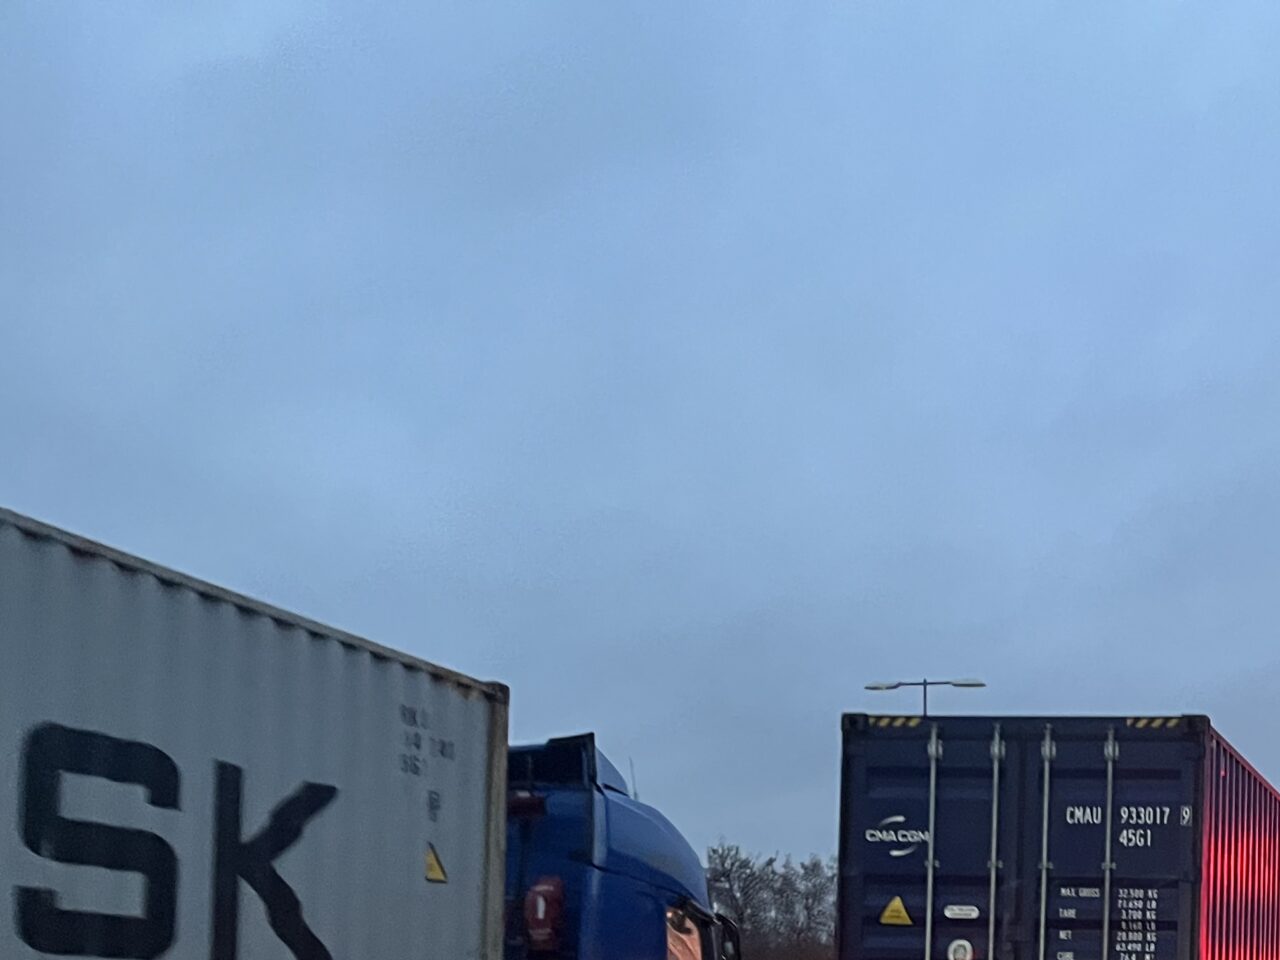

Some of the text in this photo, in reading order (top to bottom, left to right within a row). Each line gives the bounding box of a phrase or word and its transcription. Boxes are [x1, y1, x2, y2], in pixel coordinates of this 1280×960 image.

[1066, 806, 1191, 825] CMAU 933017 9
[865, 829, 897, 842] CMA
[1119, 829, 1151, 847] 45G1
[1147, 889, 1158, 899] KG
[1146, 900, 1157, 909] LB
[1059, 908, 1076, 918] TARE
[1146, 910, 1156, 919] KG
[1146, 921, 1156, 930] LB
[1059, 930, 1072, 940] NET
[1146, 932, 1157, 942] KG
[1145, 943, 1155, 952] LB
